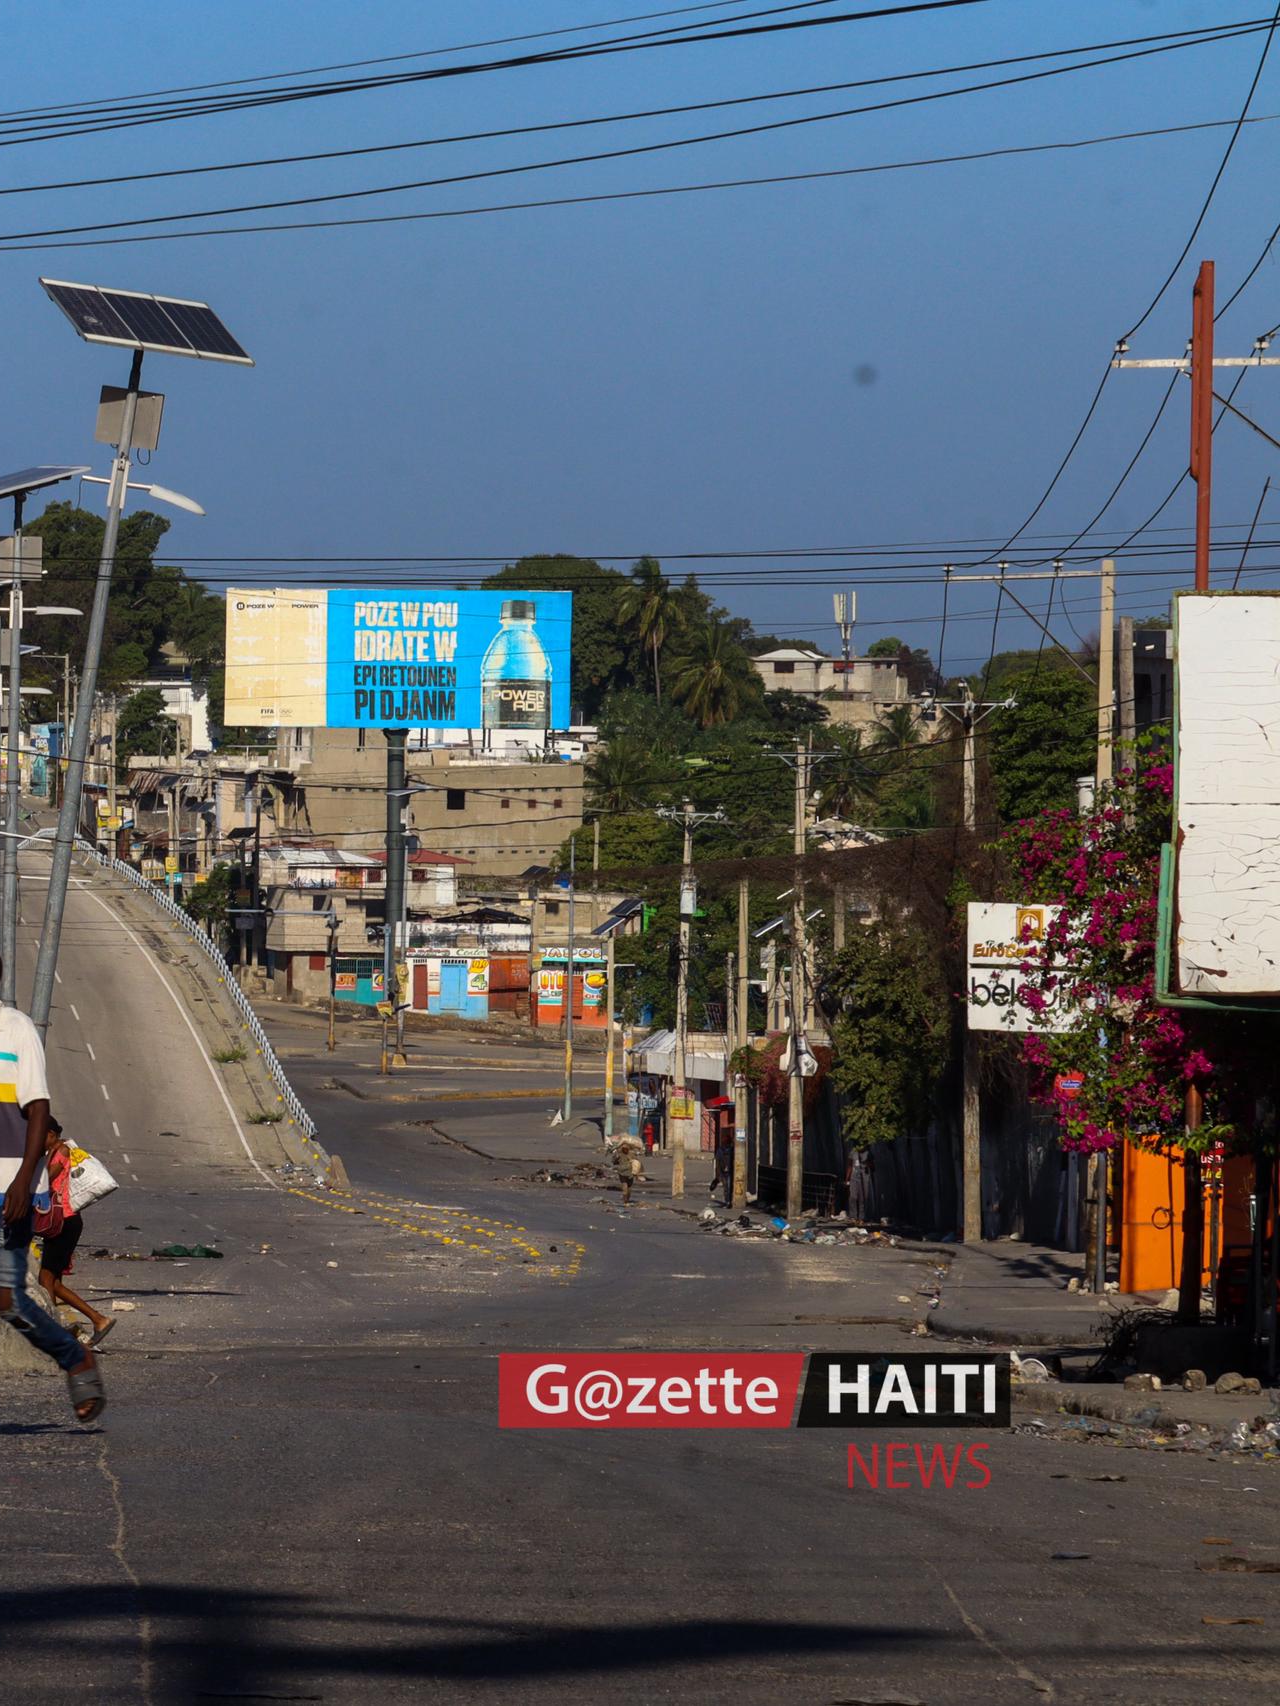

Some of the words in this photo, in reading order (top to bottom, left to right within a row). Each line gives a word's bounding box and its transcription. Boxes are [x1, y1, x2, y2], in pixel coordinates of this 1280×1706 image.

[354, 601, 399, 627] POZE
[401, 601, 420, 627] W
[422, 602, 458, 628] POU
[354, 630, 430, 662] IDRATE
[433, 630, 458, 662] W
[353, 665, 377, 686] EPI
[380, 665, 457, 688] RETOUNEN
[354, 689, 375, 720] PI
[380, 690, 456, 721] DJANM
[491, 689, 545, 701] POWER
[512, 700, 546, 712] ADE
